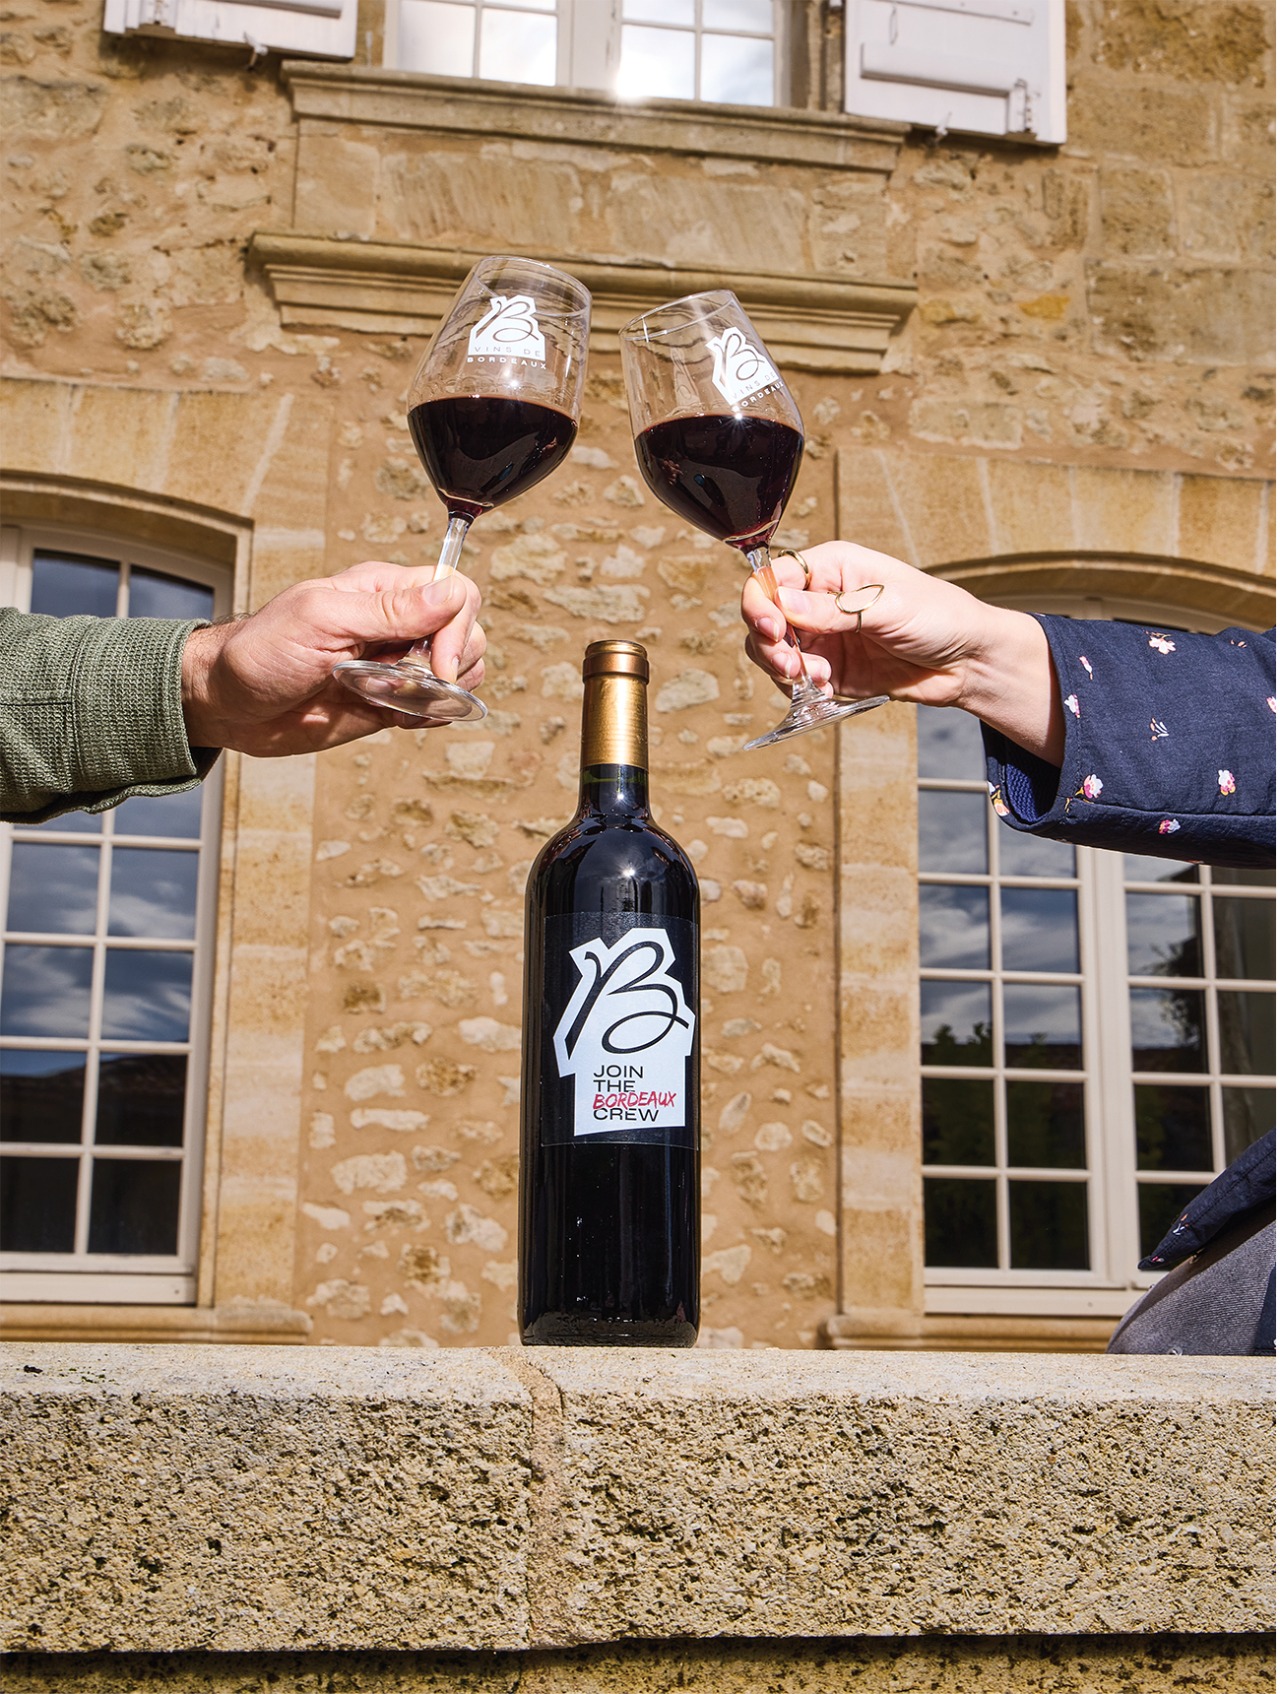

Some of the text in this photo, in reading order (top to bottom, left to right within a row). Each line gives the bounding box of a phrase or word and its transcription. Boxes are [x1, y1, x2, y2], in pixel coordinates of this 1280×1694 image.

[523, 348, 541, 357] DE
[466, 356, 547, 370] BORDEAUX
[733, 380, 761, 399] VINS
[593, 1065, 643, 1079] JOIN
[593, 1079, 636, 1093] THE
[592, 1090, 677, 1110] BORDEAUX
[593, 1107, 659, 1122] CREW
